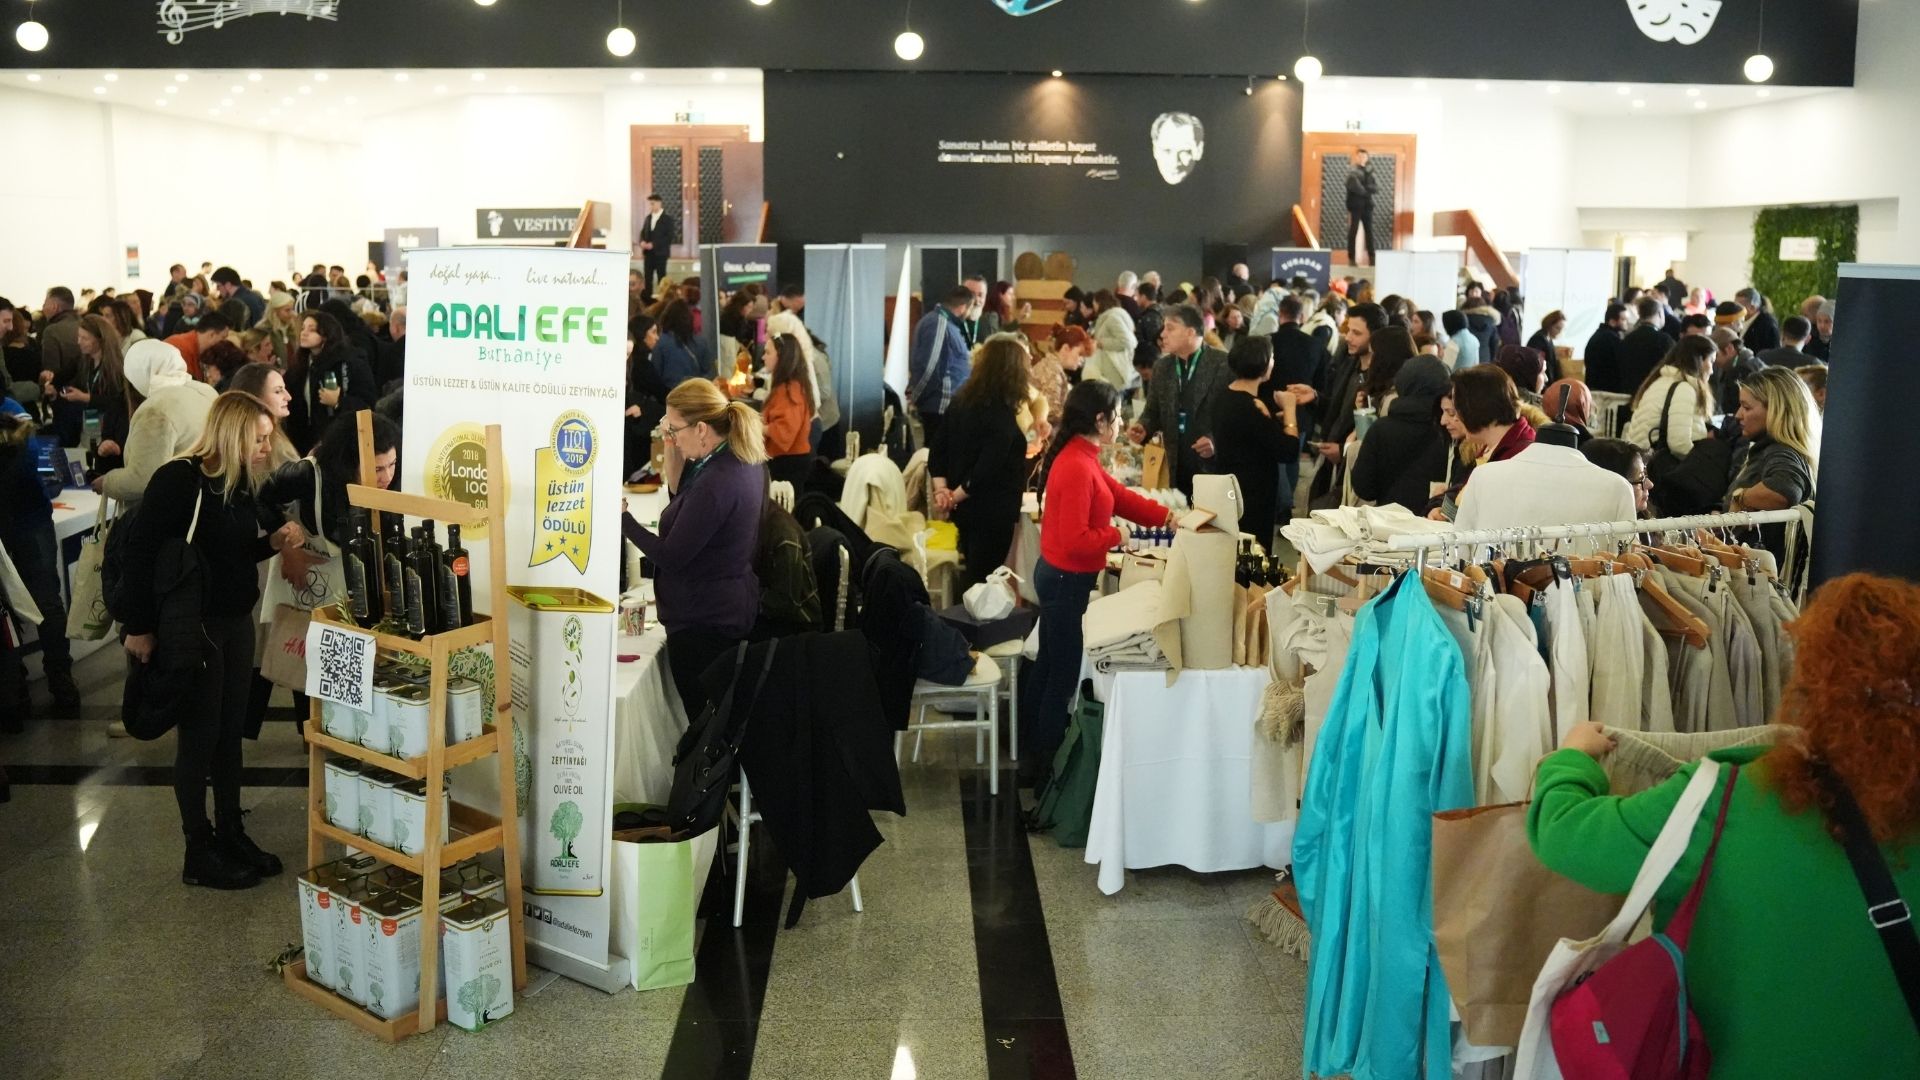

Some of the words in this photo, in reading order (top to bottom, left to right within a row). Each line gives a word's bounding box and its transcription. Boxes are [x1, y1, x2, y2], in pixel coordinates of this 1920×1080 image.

[430, 263, 461, 286] doğal
[526, 267, 549, 284] live
[427, 302, 526, 341] ADALI
[535, 305, 608, 345] EFE
[478, 346, 562, 371] Burhaniye
[412, 375, 441, 387] ÜSTÜN
[443, 378, 468, 389] LEZZET
[471, 380, 476, 389] &
[479, 378, 500, 391] ÜSTÜN
[569, 385, 618, 399] ZEYTİNYAĞI
[461, 449, 479, 461] 2018
[565, 452, 584, 463] 2018
[451, 460, 488, 480] Londo
[548, 480, 585, 496] üstün
[546, 499, 586, 513] lezzet
[542, 515, 586, 535] ÖDÜLÜ
[553, 784, 572, 794] OLIVE
[573, 785, 583, 795] OIL
